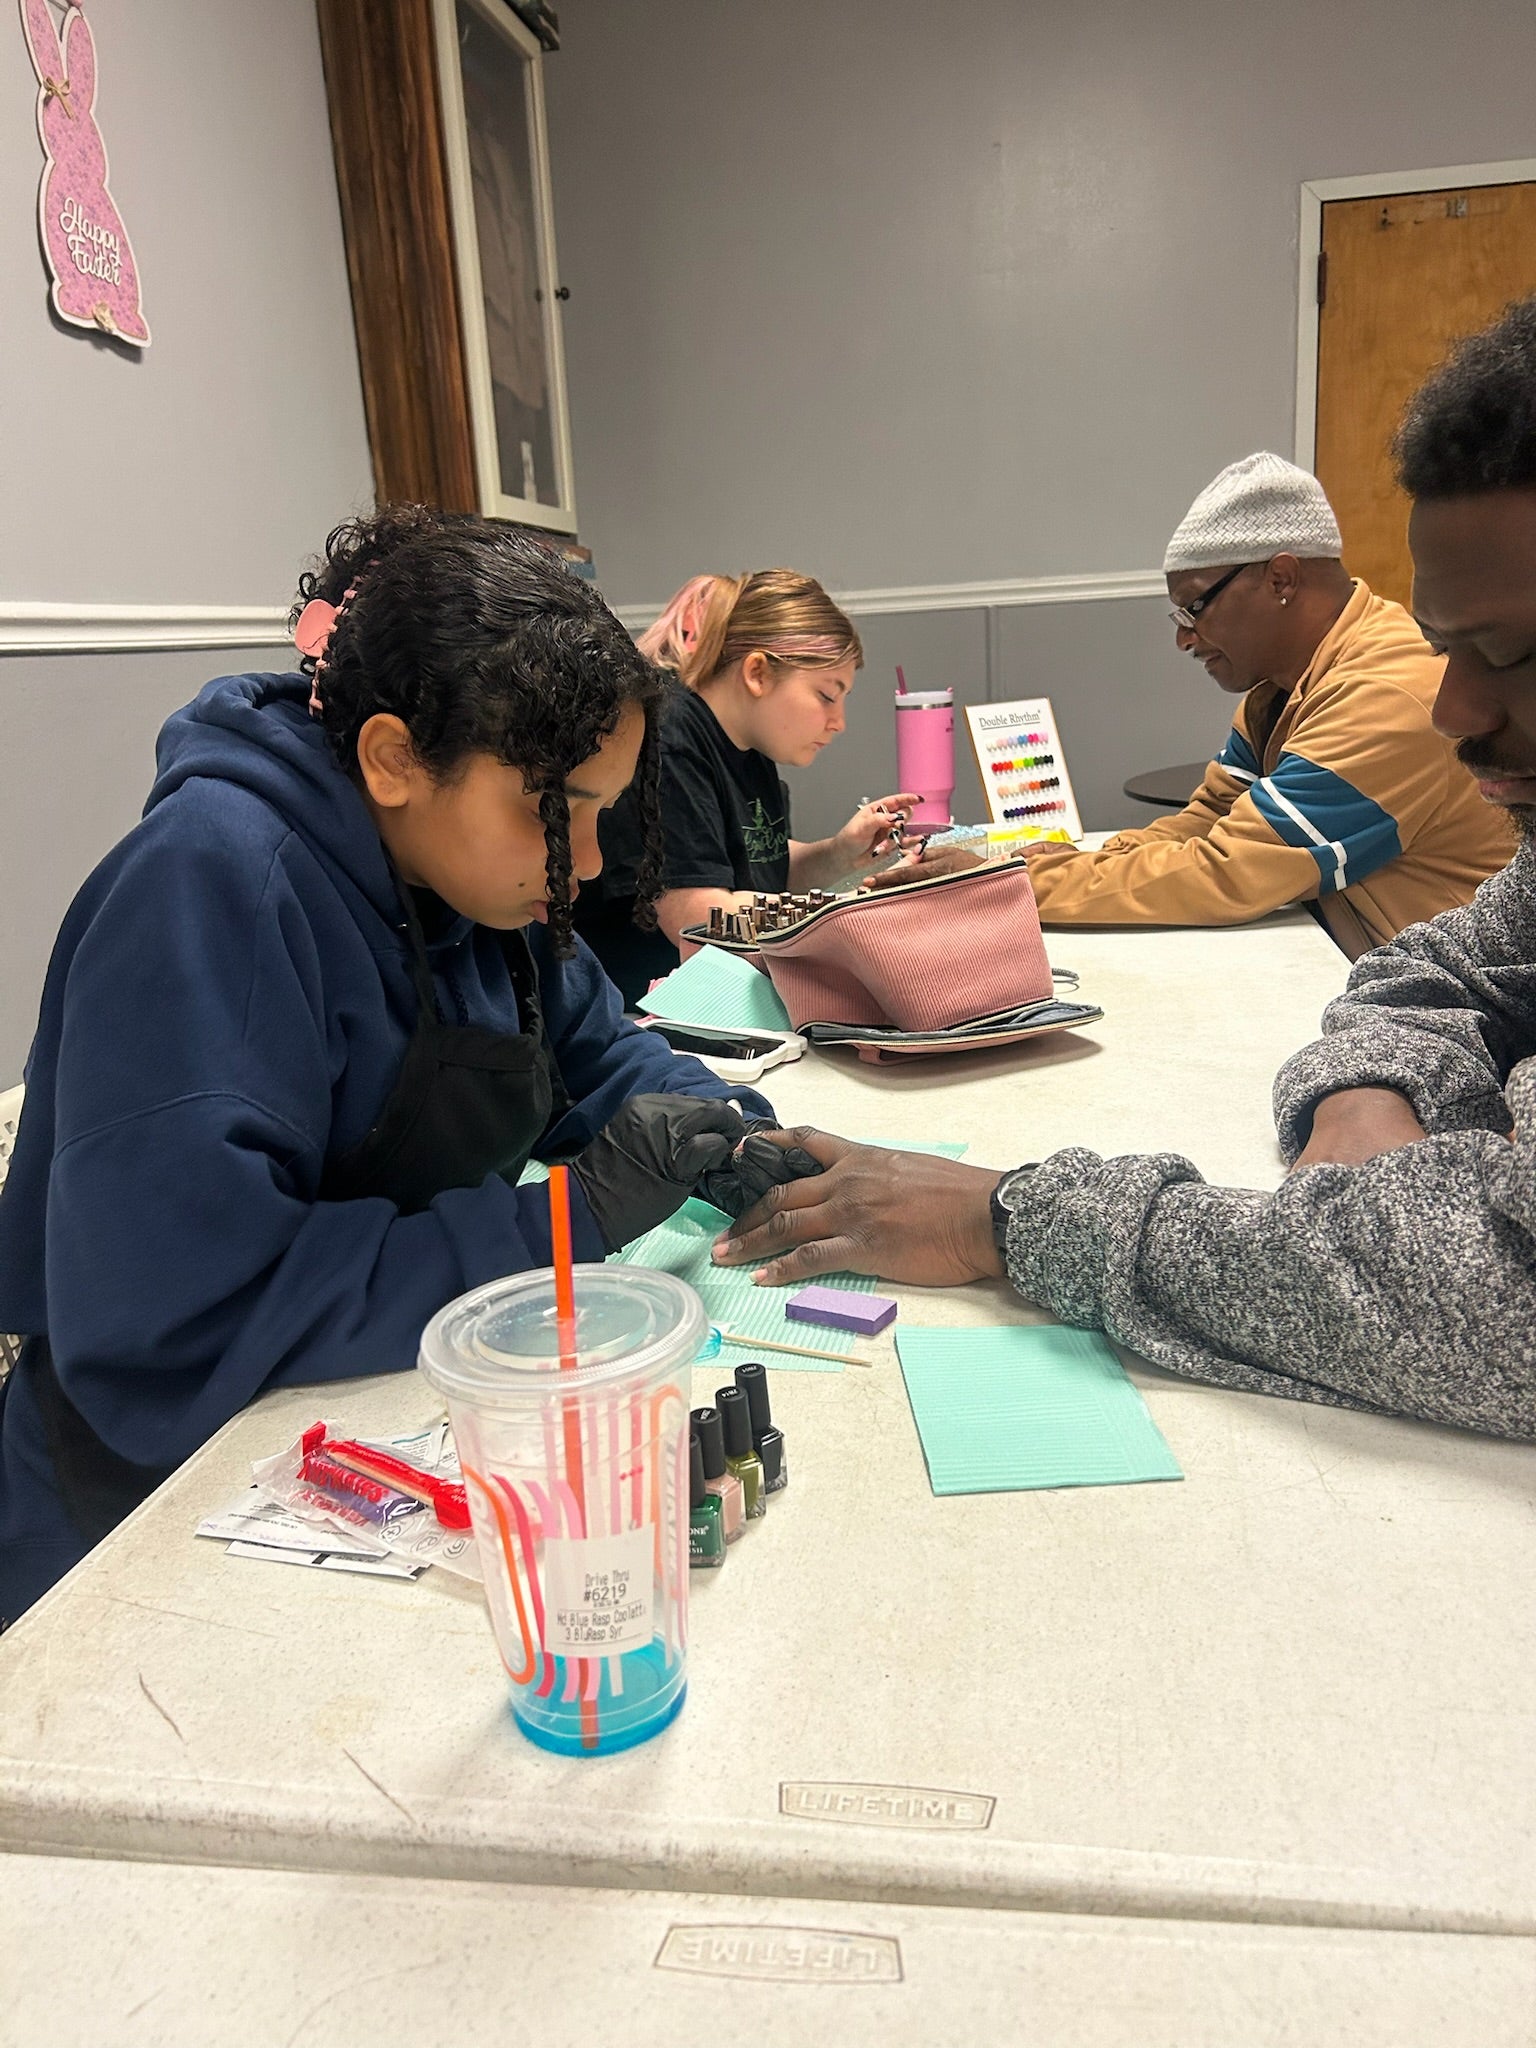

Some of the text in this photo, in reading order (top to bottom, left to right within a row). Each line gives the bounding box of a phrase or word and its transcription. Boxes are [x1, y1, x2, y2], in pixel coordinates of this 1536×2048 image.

[59, 197, 121, 266] Happy
[67, 234, 121, 286] Easter
[979, 714, 1008, 728] Double
[585, 1569, 630, 1588] Drive Thru
[584, 1583, 627, 1602] #6219
[570, 1612, 589, 1627] Blue
[592, 1612, 611, 1626] Rasp
[565, 1627, 571, 1641] 3
[609, 1625, 623, 1639] Syr
[800, 1791, 975, 1820] LIFETIME
[679, 1937, 878, 1971] LIFETIME
